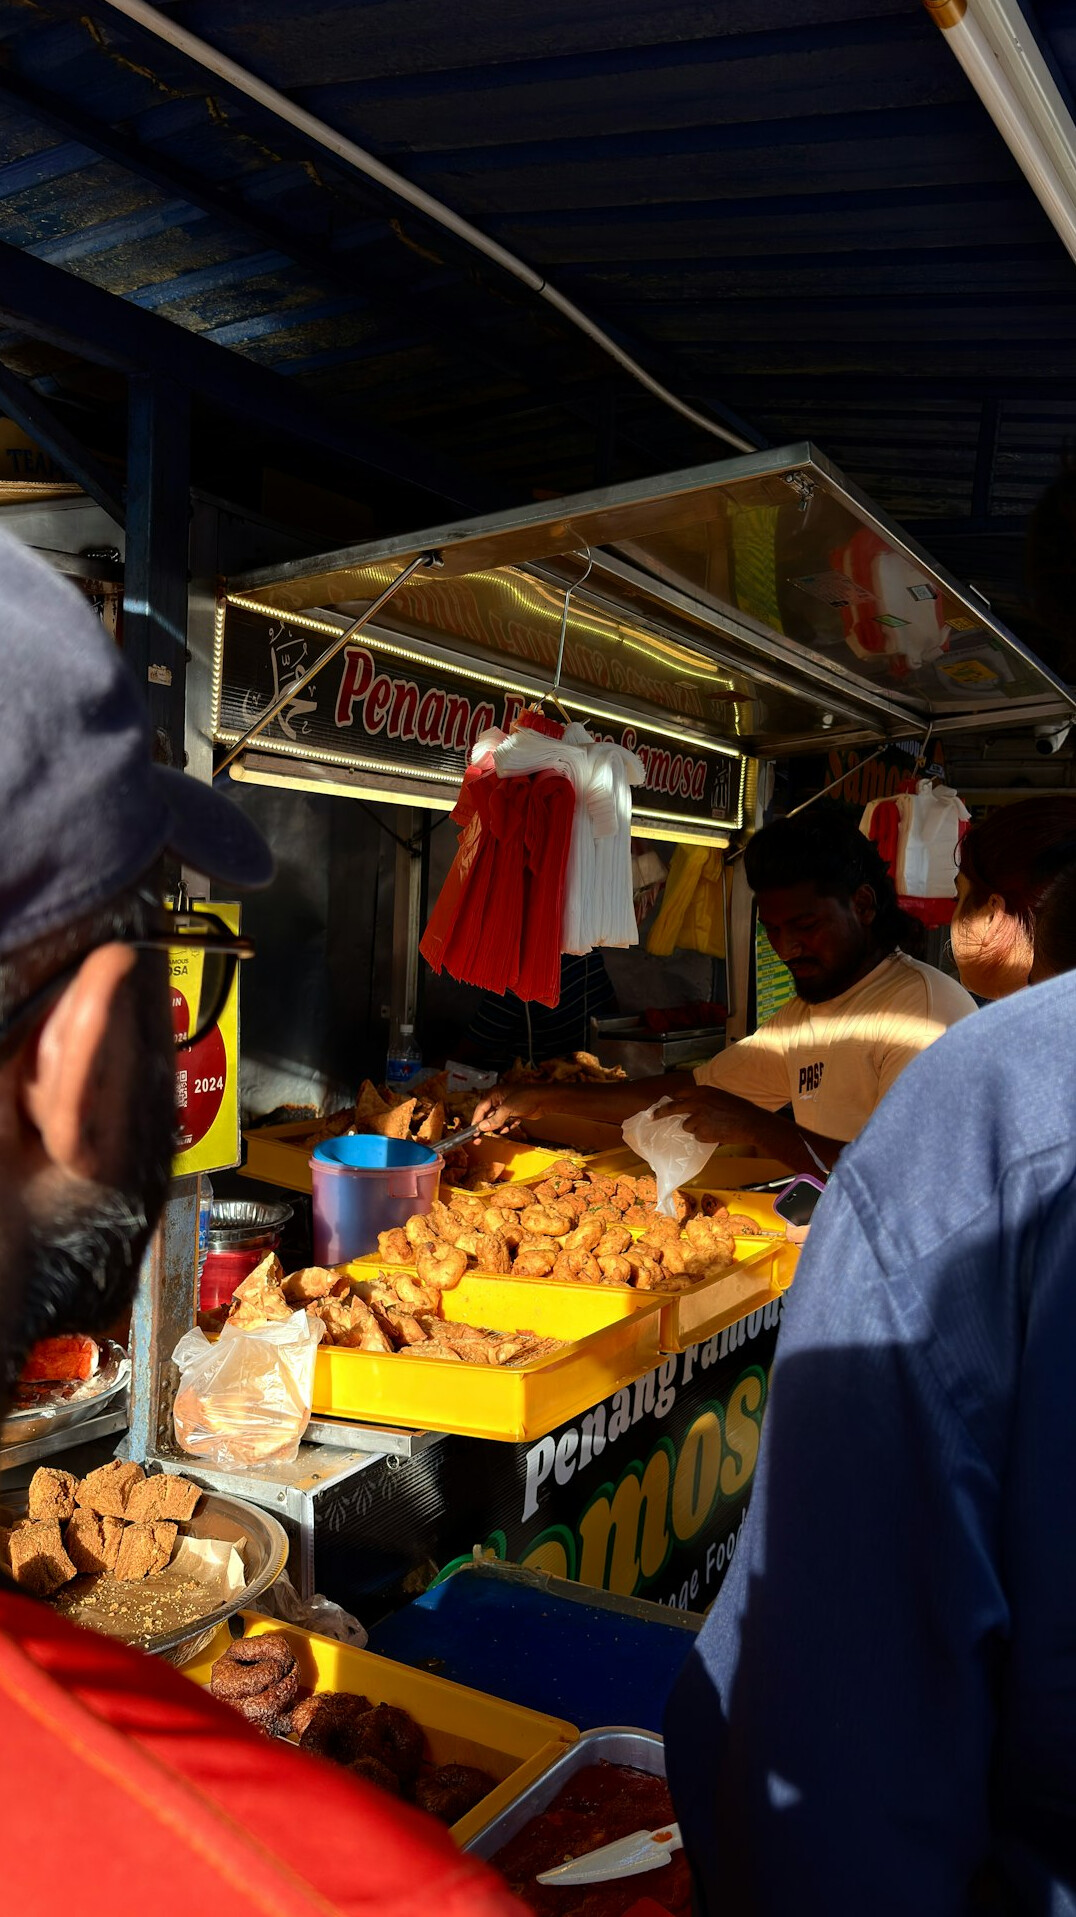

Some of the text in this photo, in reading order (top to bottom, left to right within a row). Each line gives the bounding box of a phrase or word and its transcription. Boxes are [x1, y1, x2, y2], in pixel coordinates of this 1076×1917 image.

[334, 645, 497, 768] Penang
[194, 1075, 224, 1094] 2024
[521, 1294, 784, 1524] Penang Famou
